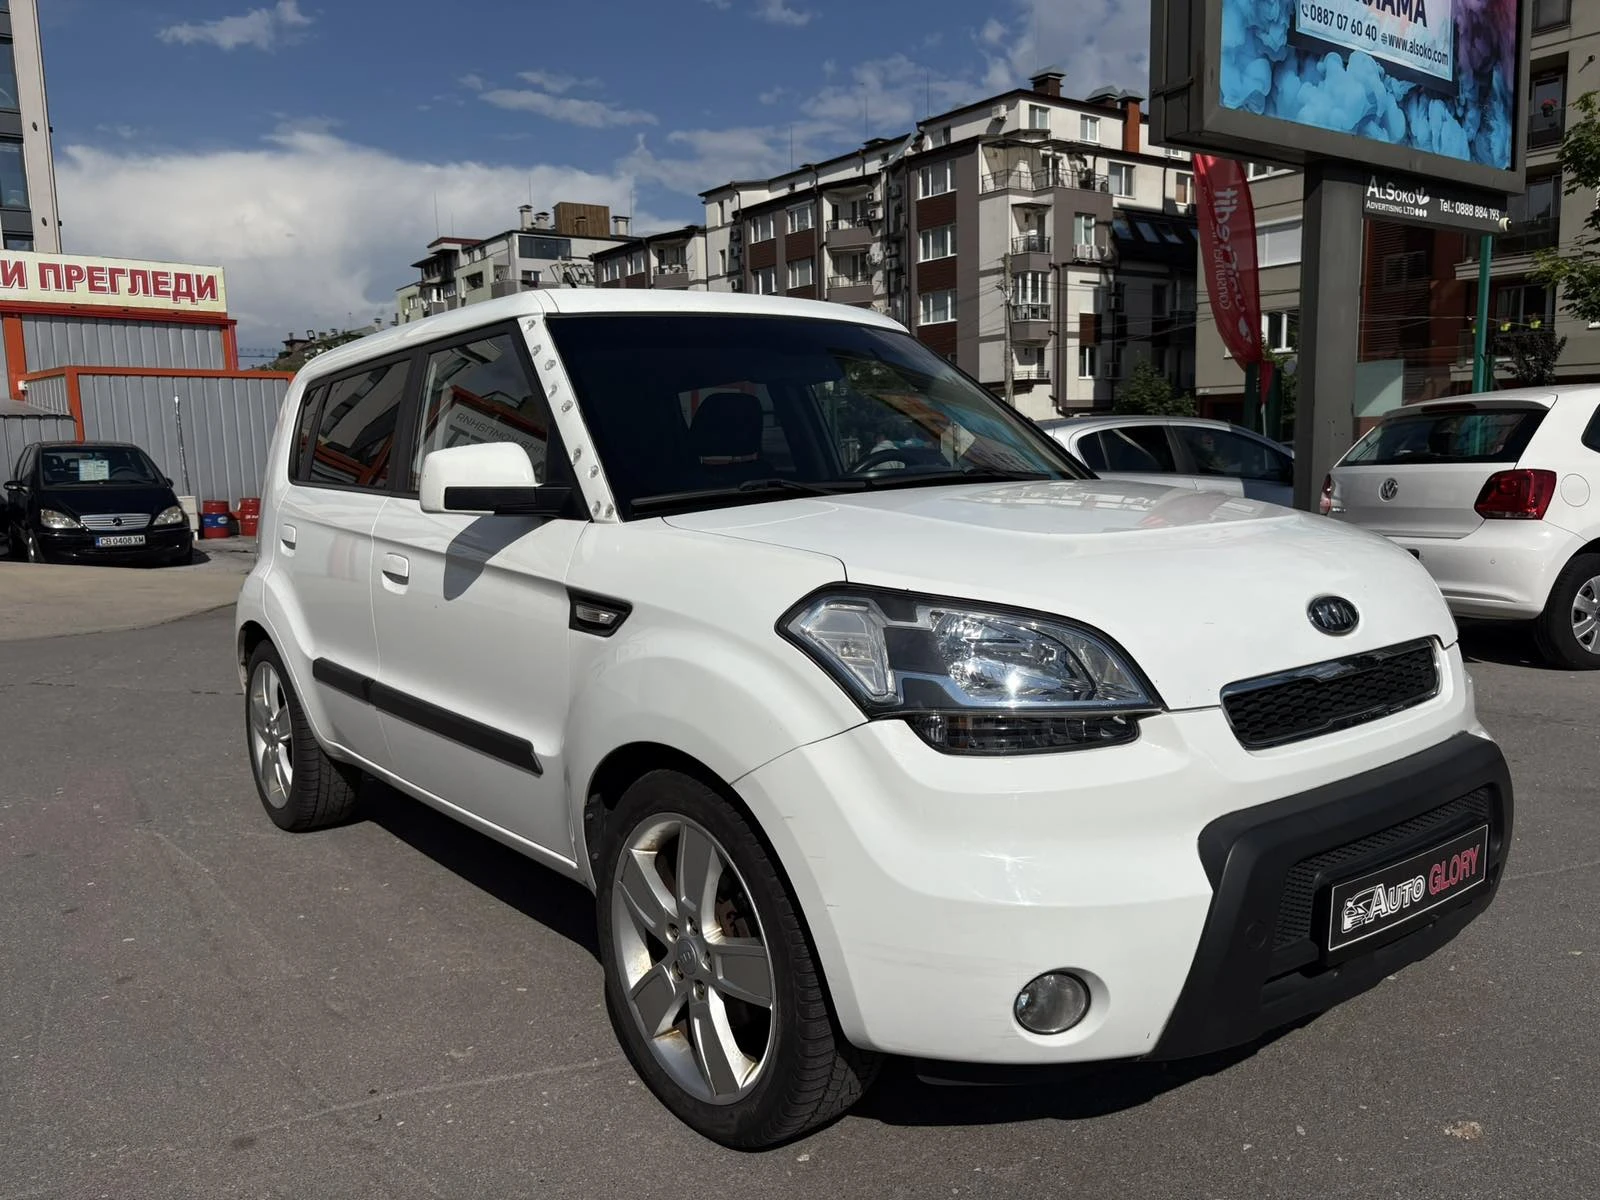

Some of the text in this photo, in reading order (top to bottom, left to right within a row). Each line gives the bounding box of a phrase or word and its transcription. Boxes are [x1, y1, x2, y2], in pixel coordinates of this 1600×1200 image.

[1310, 4, 1377, 42] 0887 07 60 40
[1388, 33, 1449, 67] www.alsoko.com
[1455, 201, 1474, 217] 0888
[1474, 205, 1489, 219] 884
[38, 262, 220, 305] ПРЕГЛЕДИ
[1314, 601, 1355, 629] KIA
[1428, 843, 1481, 896] GLORY
